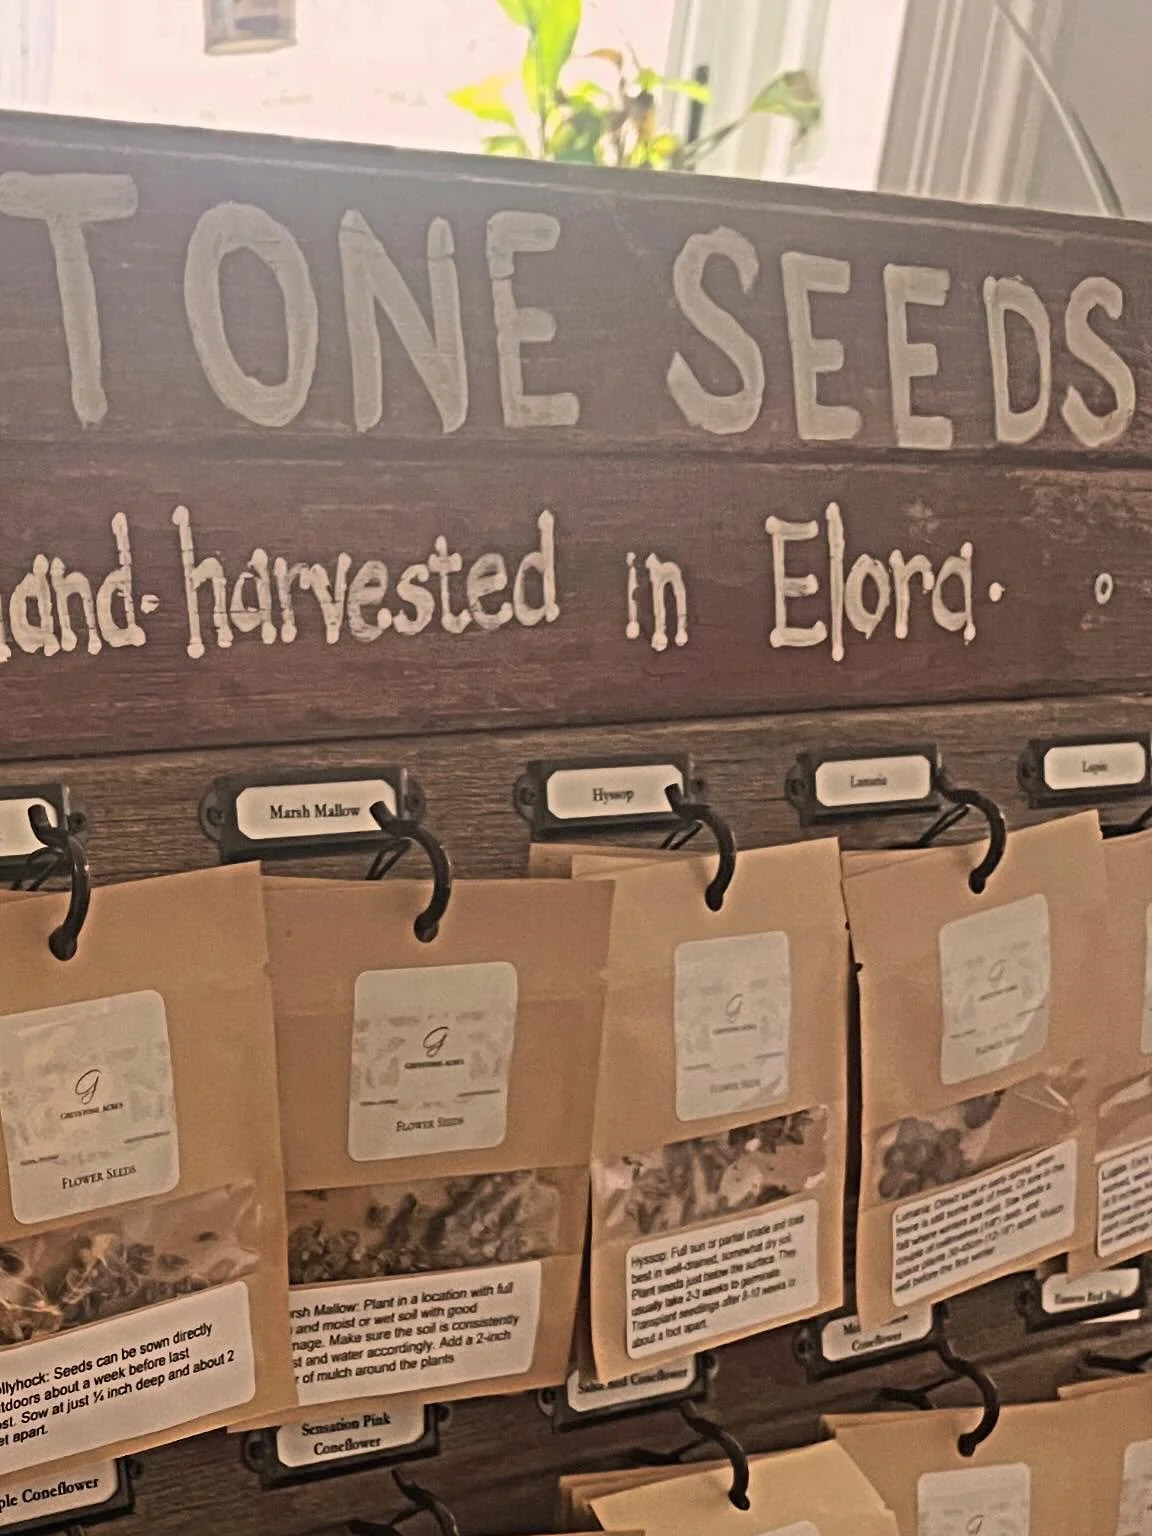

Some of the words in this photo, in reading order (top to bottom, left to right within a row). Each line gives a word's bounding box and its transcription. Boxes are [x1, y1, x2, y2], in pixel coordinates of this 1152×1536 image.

[667, 227, 1135, 449] SEEDS
[625, 552, 687, 651] in
[765, 502, 1006, 662] Elora.
[269, 803, 310, 820] Marsh
[314, 802, 361, 819] Mallow
[591, 787, 635, 804] Hyssop
[53, 1359, 93, 1380] Seeds
[95, 1352, 118, 1368] can
[120, 1347, 136, 1360] be
[138, 1336, 170, 1355] sown
[172, 1322, 212, 1344] directly
[20, 1407, 49, 1424] Sow
[51, 1401, 64, 1415] at
[65, 1394, 89, 1413] just
[106, 1382, 132, 1399] inch
[135, 1373, 165, 1391] deep
[167, 1362, 190, 1381] and
[192, 1352, 225, 1373] about
[226, 1349, 234, 1362] 2
[43, 1379, 80, 1400] about
[81, 1378, 90, 1389] a
[93, 1366, 126, 1386] week
[128, 1356, 166, 1376] before
[168, 1346, 190, 1363] last
[301, 1417, 361, 1437] Sensation
[362, 1412, 392, 1427] Pink
[313, 1437, 383, 1456] Coneflower
[22, 1478, 99, 1502] Coneflower
